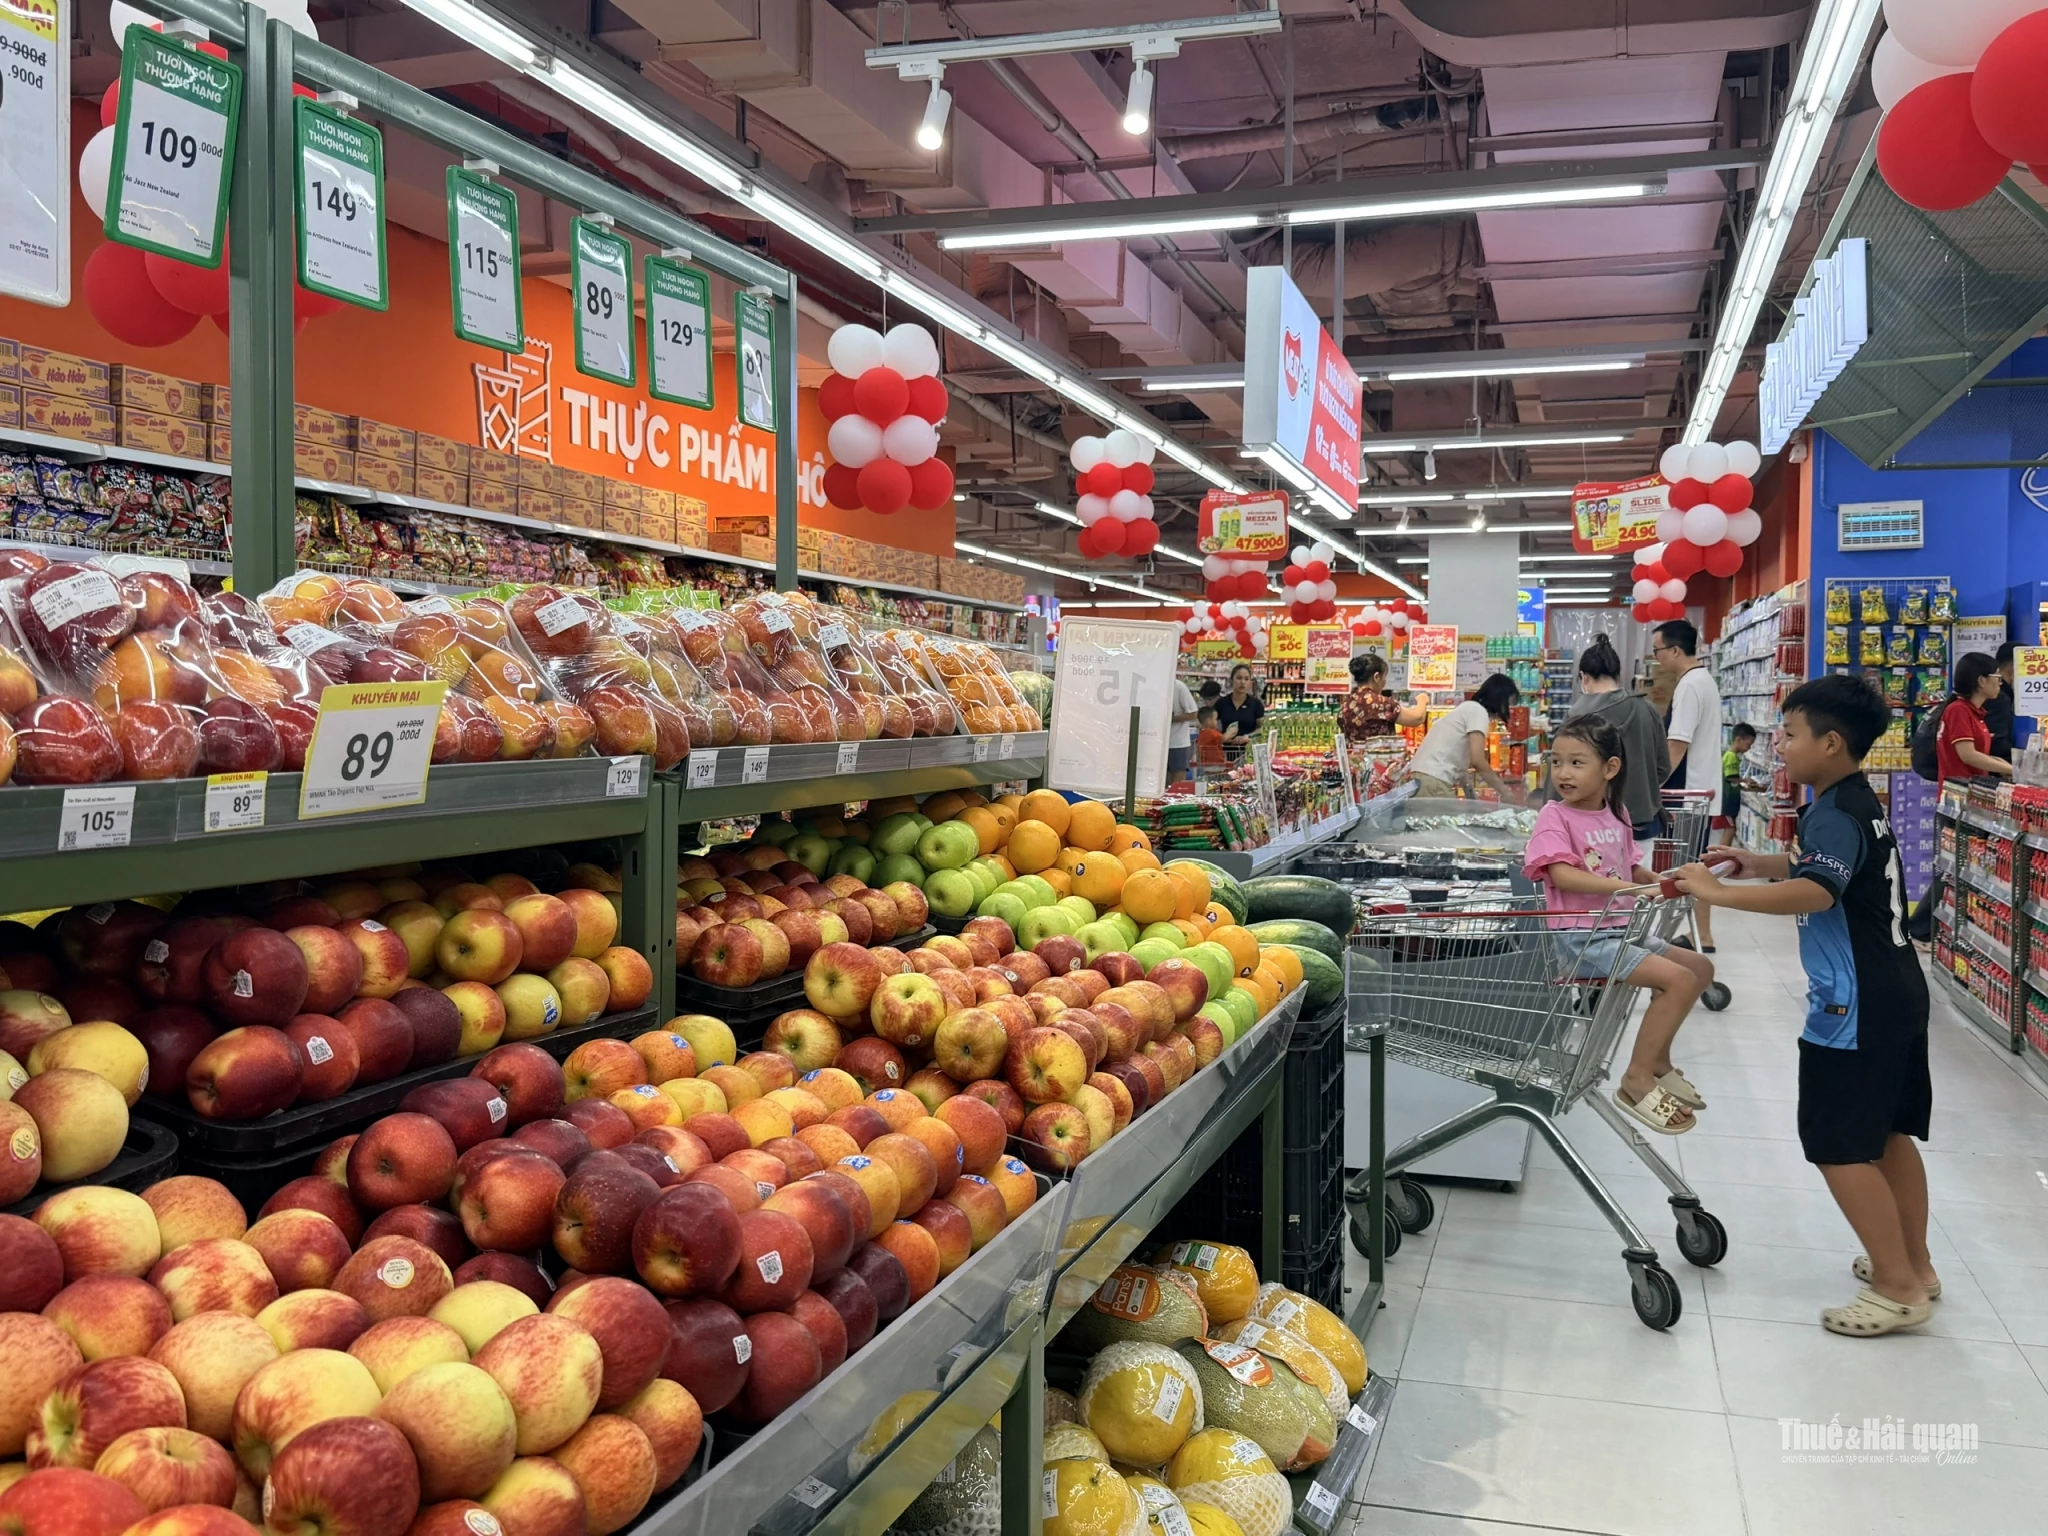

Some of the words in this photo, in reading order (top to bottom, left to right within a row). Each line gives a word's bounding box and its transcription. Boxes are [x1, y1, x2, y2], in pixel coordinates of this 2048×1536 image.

[156, 51, 182, 71] TƯƠI
[184, 63, 214, 85] NGON
[191, 82, 222, 103] HẠNG
[315, 119, 336, 134] TƯƠI
[337, 128, 361, 148] NGON
[142, 122, 197, 169] 109
[308, 130, 344, 153] THƯỢNG
[346, 146, 369, 164] HẠNG
[312, 181, 356, 222] 149
[466, 186, 482, 200] TƯƠI
[483, 194, 500, 209] NGON
[464, 242, 498, 278] 115
[661, 271, 677, 282] TƯƠI
[677, 275, 695, 289] NGON
[587, 281, 613, 320] 89
[660, 318, 692, 347] 129
[560, 387, 671, 474] THỰC
[679, 415, 768, 494] PHẨM
[1630, 497, 1661, 507] SLIDE
[352, 688, 398, 705] KHUYẾN
[399, 690, 421, 704] MẠI
[341, 731, 394, 781] 89
[751, 761, 763, 773] 149
[843, 754, 853, 764] 115
[617, 770, 632, 784] 129
[696, 764, 710, 778] 129
[233, 795, 251, 813] 89
[81, 810, 115, 832] 105
[1585, 827, 1622, 846] LUCY
[1112, 1273, 1132, 1312] Pansy
